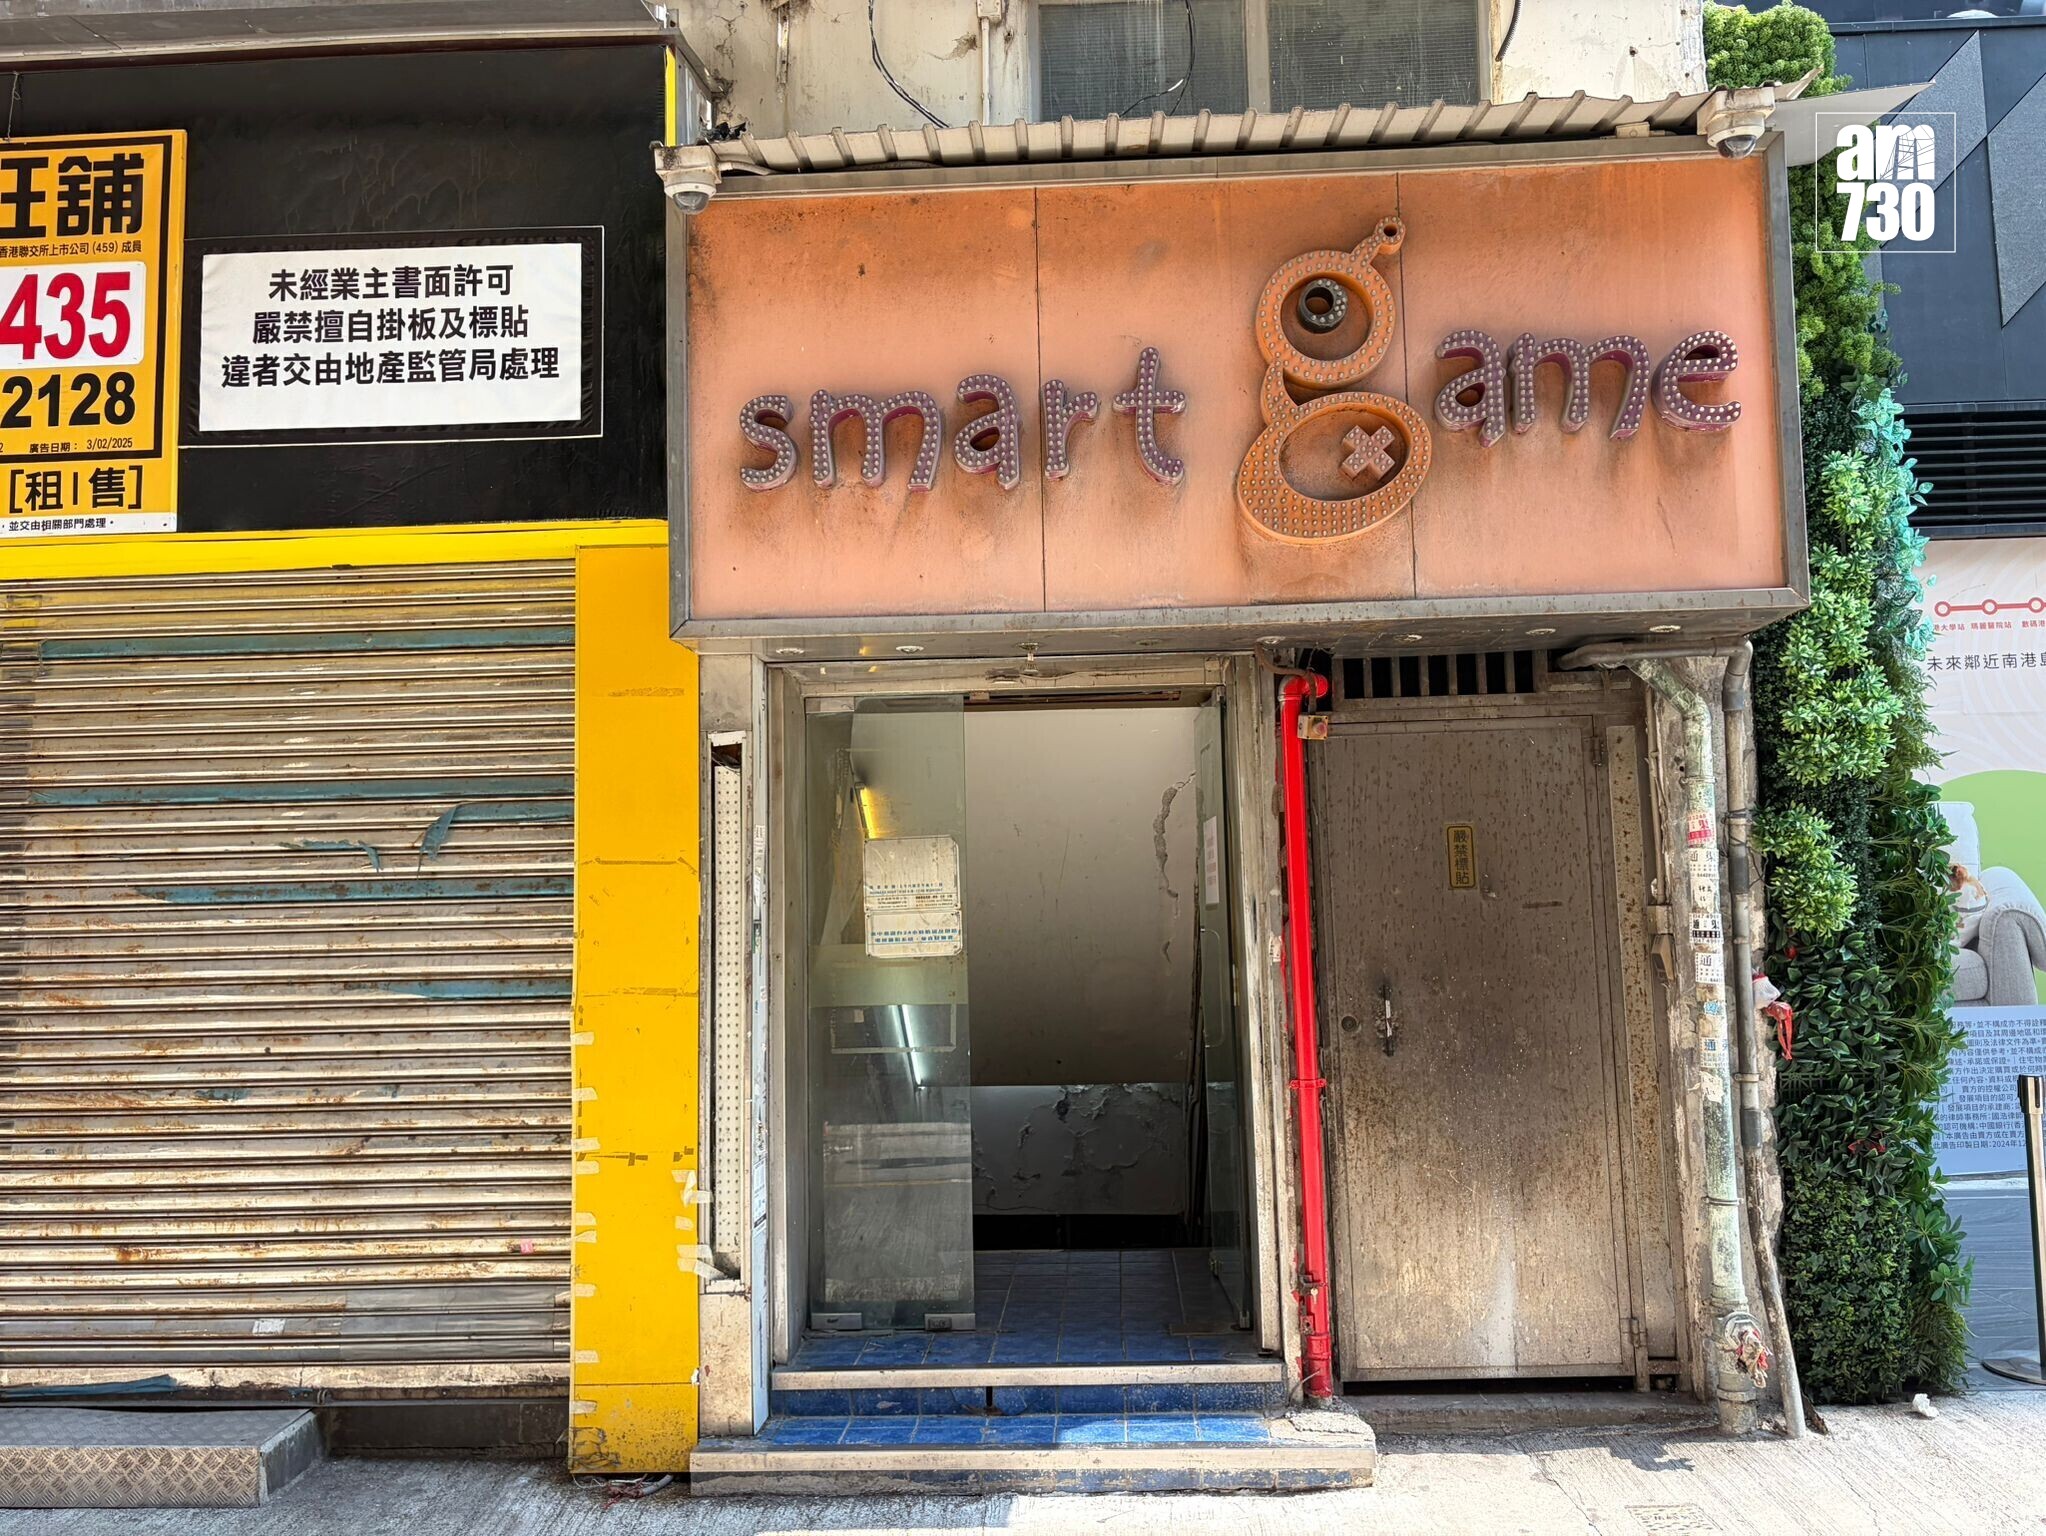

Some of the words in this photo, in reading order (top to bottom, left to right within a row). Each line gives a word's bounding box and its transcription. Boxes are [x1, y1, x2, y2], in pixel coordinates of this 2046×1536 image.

[92, 241, 118, 255] (459)
[121, 239, 142, 253] 成員
[268, 264, 514, 302] 未經業主書面許可
[0, 271, 131, 361] 435
[252, 304, 530, 345] 嚴禁擅自掛板及標貼
[221, 346, 560, 389] 違者交由地產監管局處理
[739, 346, 1187, 493] smart
[1236, 215, 1742, 544] game
[0, 371, 136, 429] 2128
[86, 437, 133, 450] 3/02/2025
